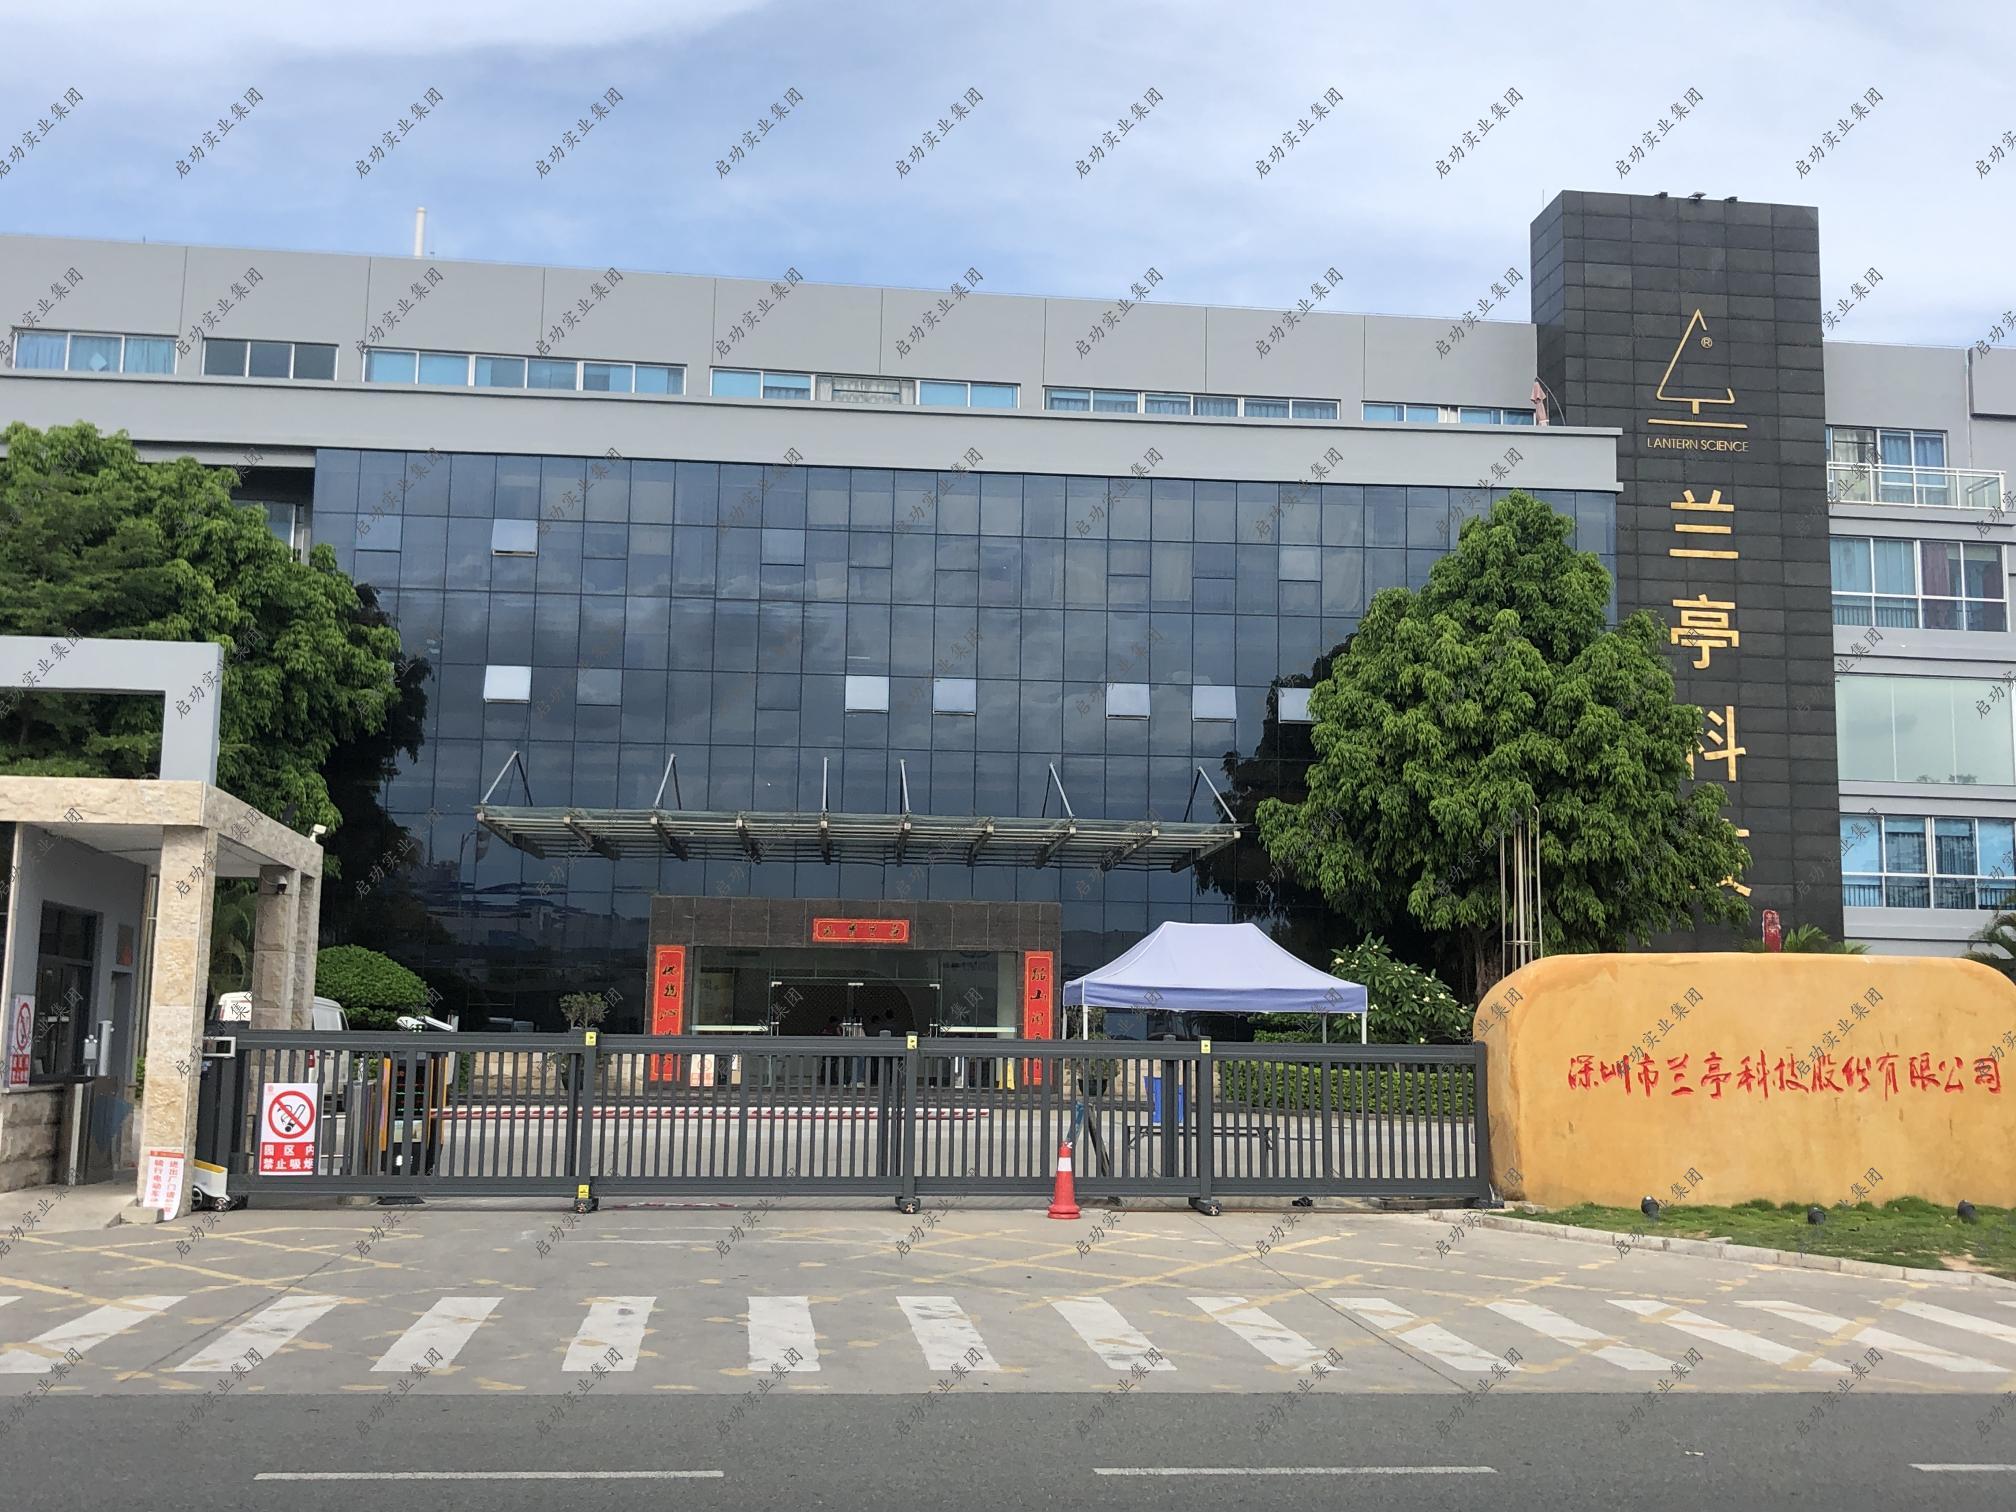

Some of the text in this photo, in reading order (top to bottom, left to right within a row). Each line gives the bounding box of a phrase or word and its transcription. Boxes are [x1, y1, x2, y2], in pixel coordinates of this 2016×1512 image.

[1647, 437, 1749, 452] LANTERN SCIENCE
[1669, 489, 1752, 897] 兰亭科
[1568, 1049, 2003, 1101] 深圳市兰亭科技股份有限公司
[264, 1158, 314, 1170] 禁止吸烟
